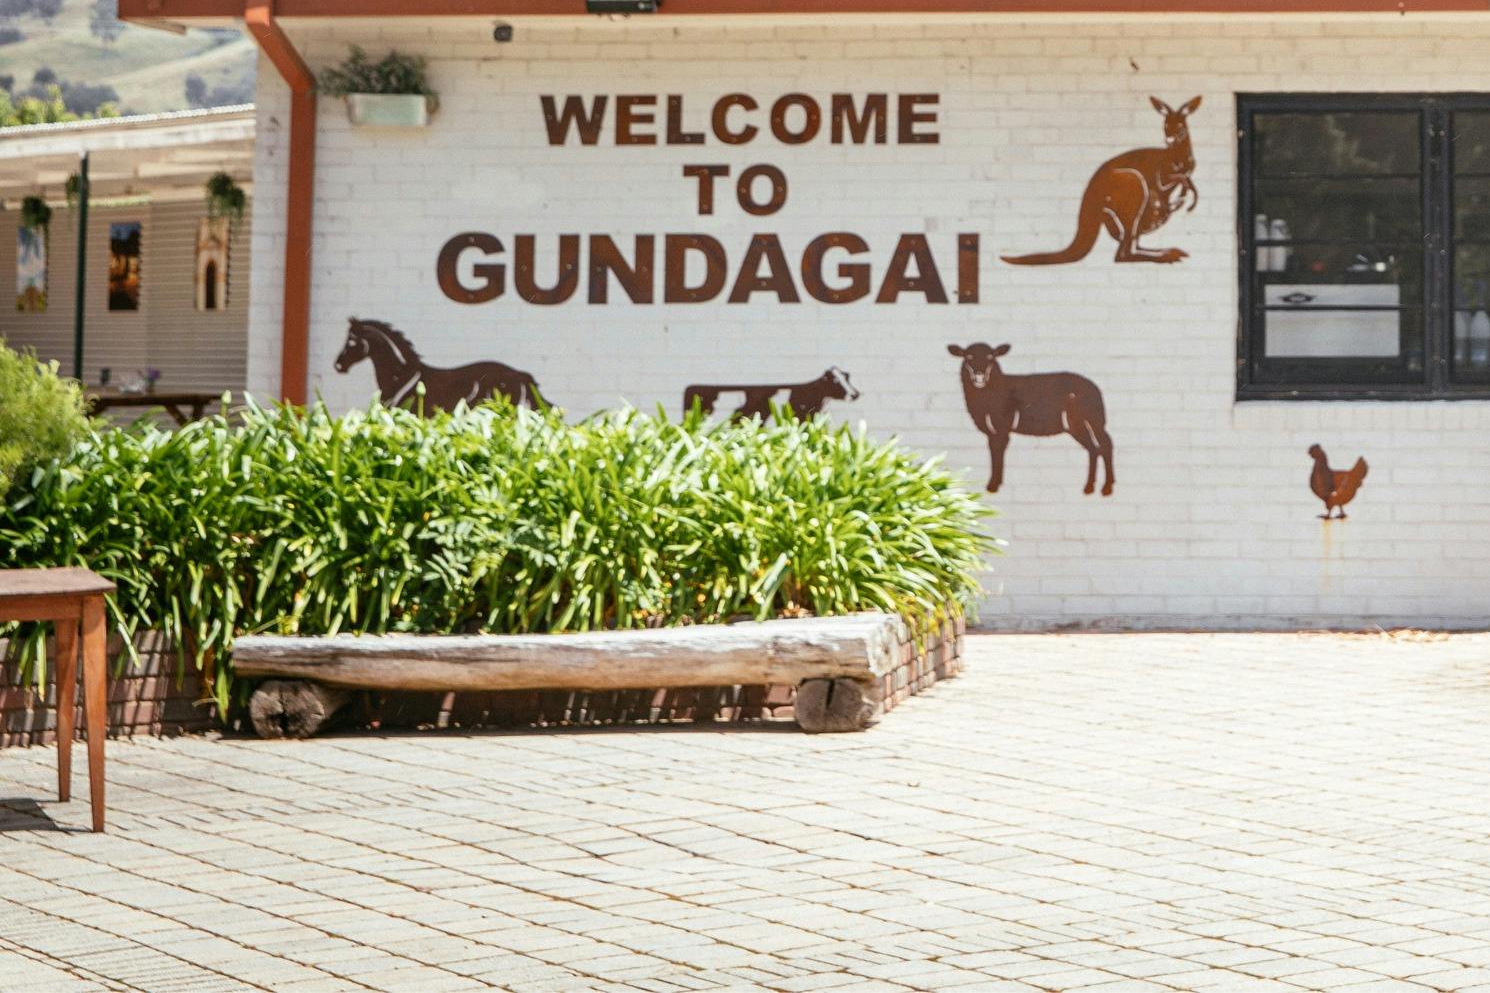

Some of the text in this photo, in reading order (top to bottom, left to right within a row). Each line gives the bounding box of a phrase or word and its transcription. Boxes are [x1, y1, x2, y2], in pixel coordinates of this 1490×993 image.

[539, 92, 941, 147] WELCOME
[683, 163, 789, 216] TO
[436, 231, 981, 306] GUNDAGAI
